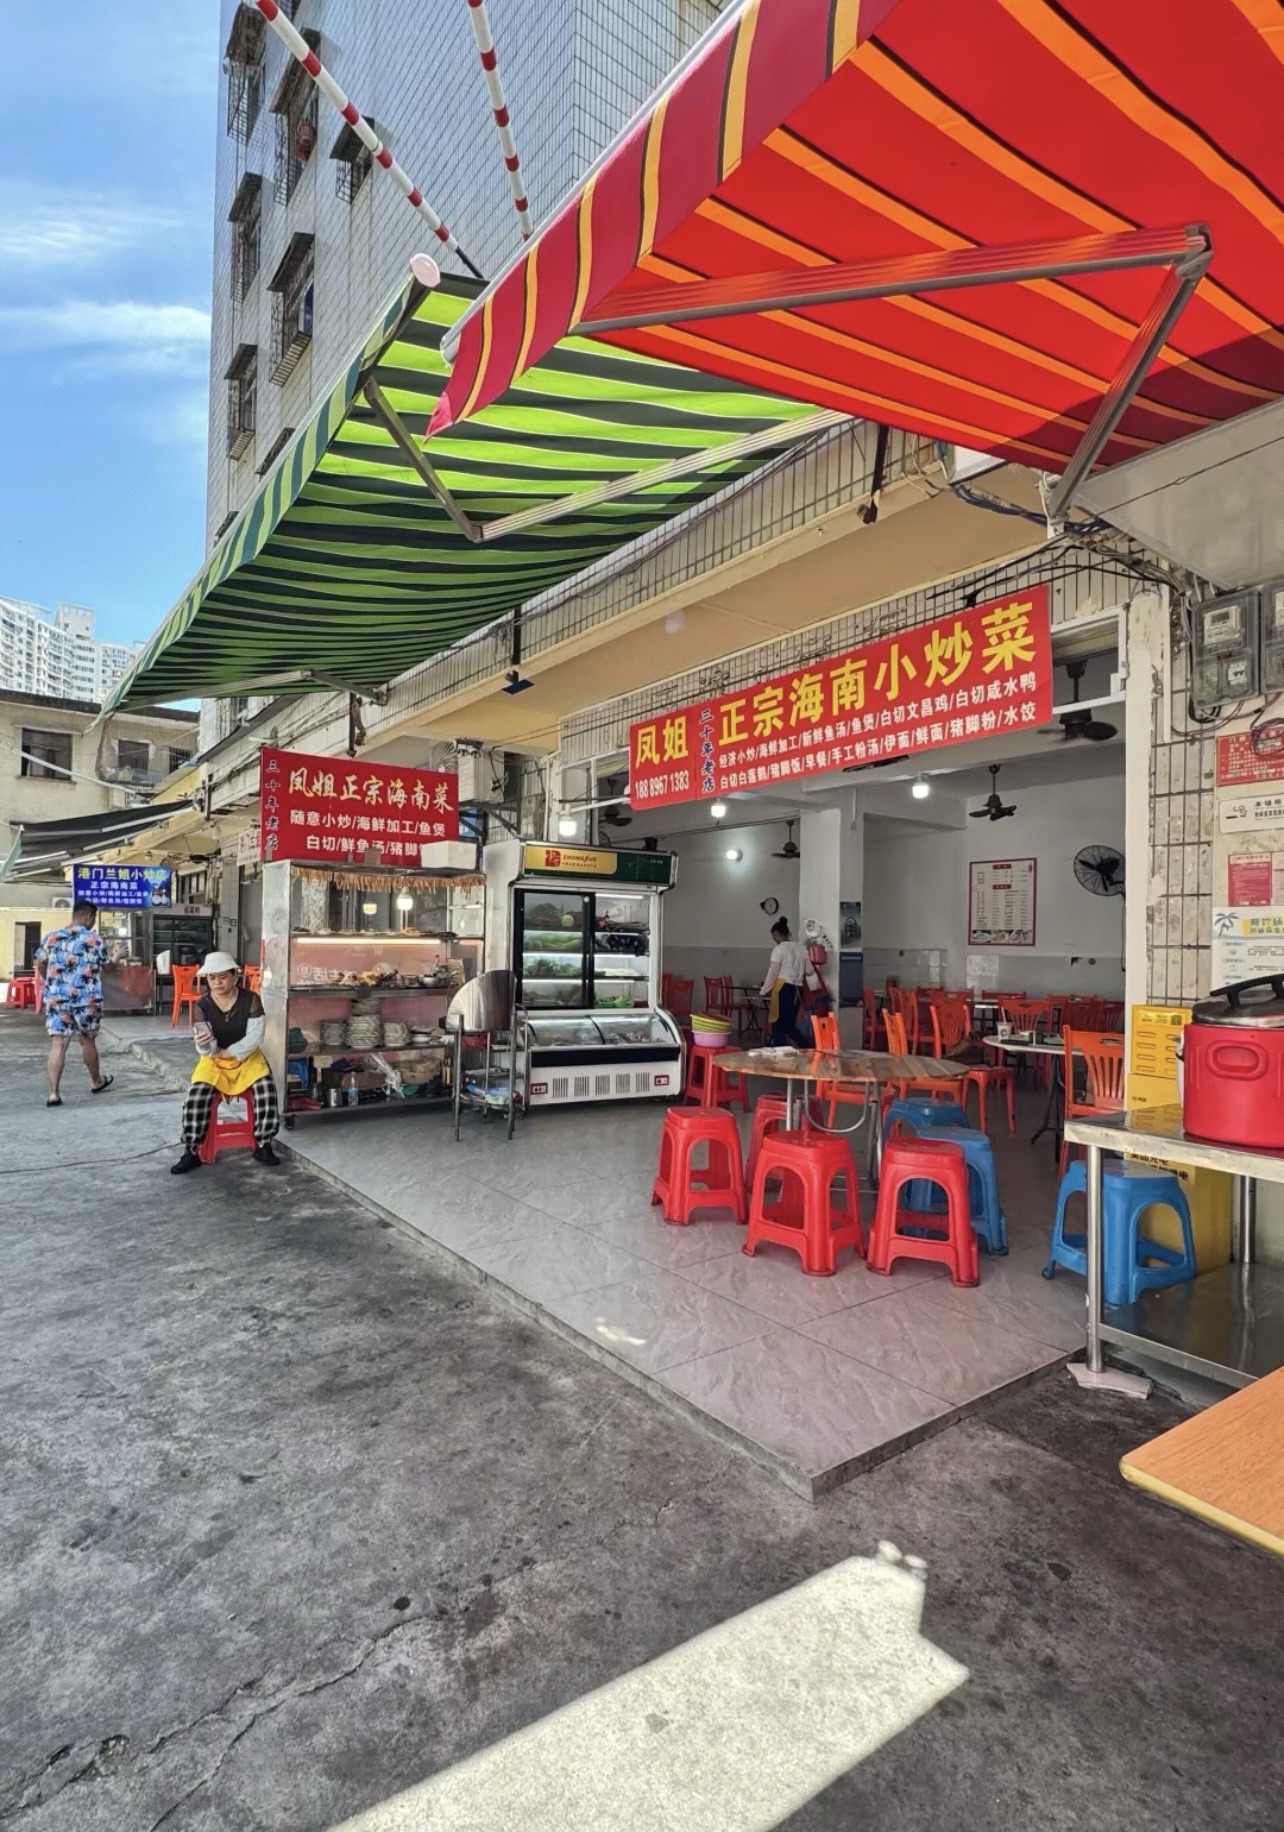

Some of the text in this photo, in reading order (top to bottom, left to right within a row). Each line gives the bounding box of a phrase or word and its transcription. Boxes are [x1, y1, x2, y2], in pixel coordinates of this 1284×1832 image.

[718, 601, 1037, 747] 正宗海南小炒菜
[635, 715, 689, 769] 凤姐
[699, 708, 716, 795] 三十年老店
[265, 759, 281, 851] 三十年老店
[288, 766, 454, 815] 凤姐正宗海南菜
[634, 769, 690, 799] 188 8967 1383
[289, 809, 446, 837] 随意小炒/海鲜加工/鱼煲
[306, 834, 423, 857] 白切/鲜鱼汤/猪脚
